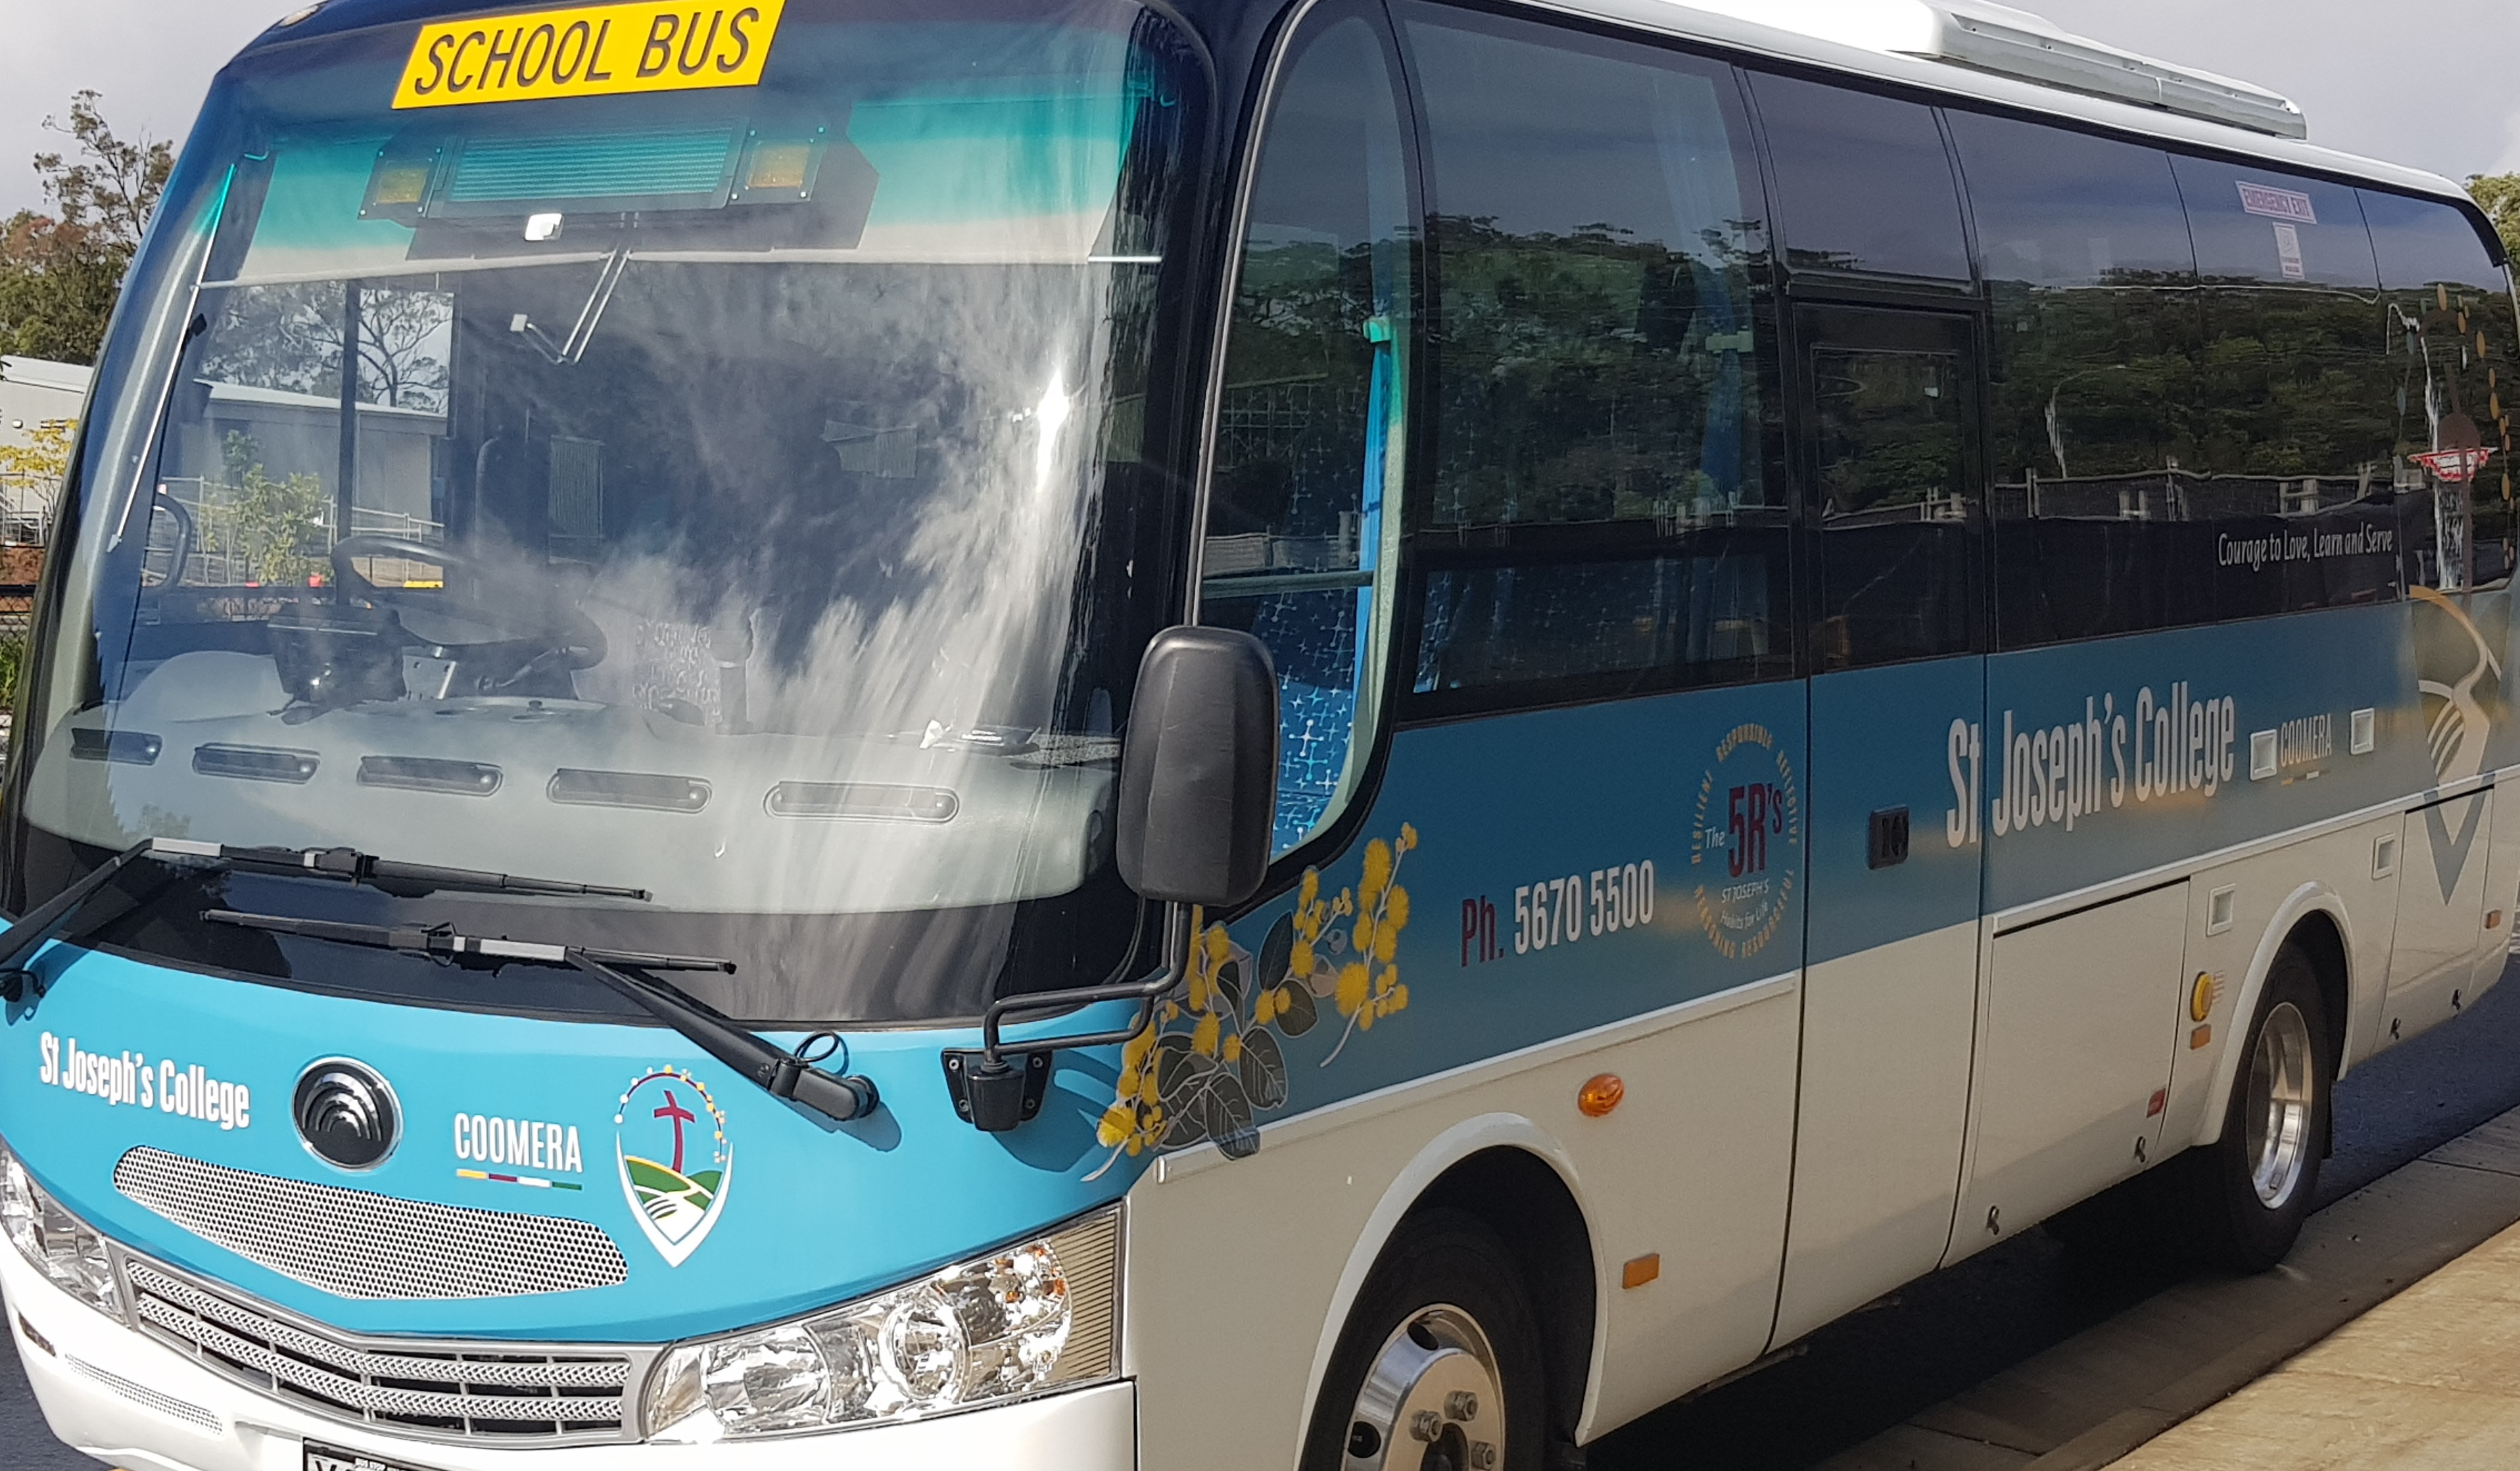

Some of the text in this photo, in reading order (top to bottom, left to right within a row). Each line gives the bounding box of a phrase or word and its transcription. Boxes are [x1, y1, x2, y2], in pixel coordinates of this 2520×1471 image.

[415, 7, 759, 95] SCHOOL BUS
[2218, 521, 2392, 572] Courage to Love, Learn and Serve
[1947, 681, 2234, 848] St Joseph's College
[2281, 713, 2332, 768] COOMERA
[1705, 783, 1783, 879] The 5R's
[1461, 859, 1655, 968] Ph. 5670 5500
[1721, 888, 1732, 904] ST
[40, 1031, 250, 1131] St Joseph's College
[454, 1112, 583, 1174] COOMERA
